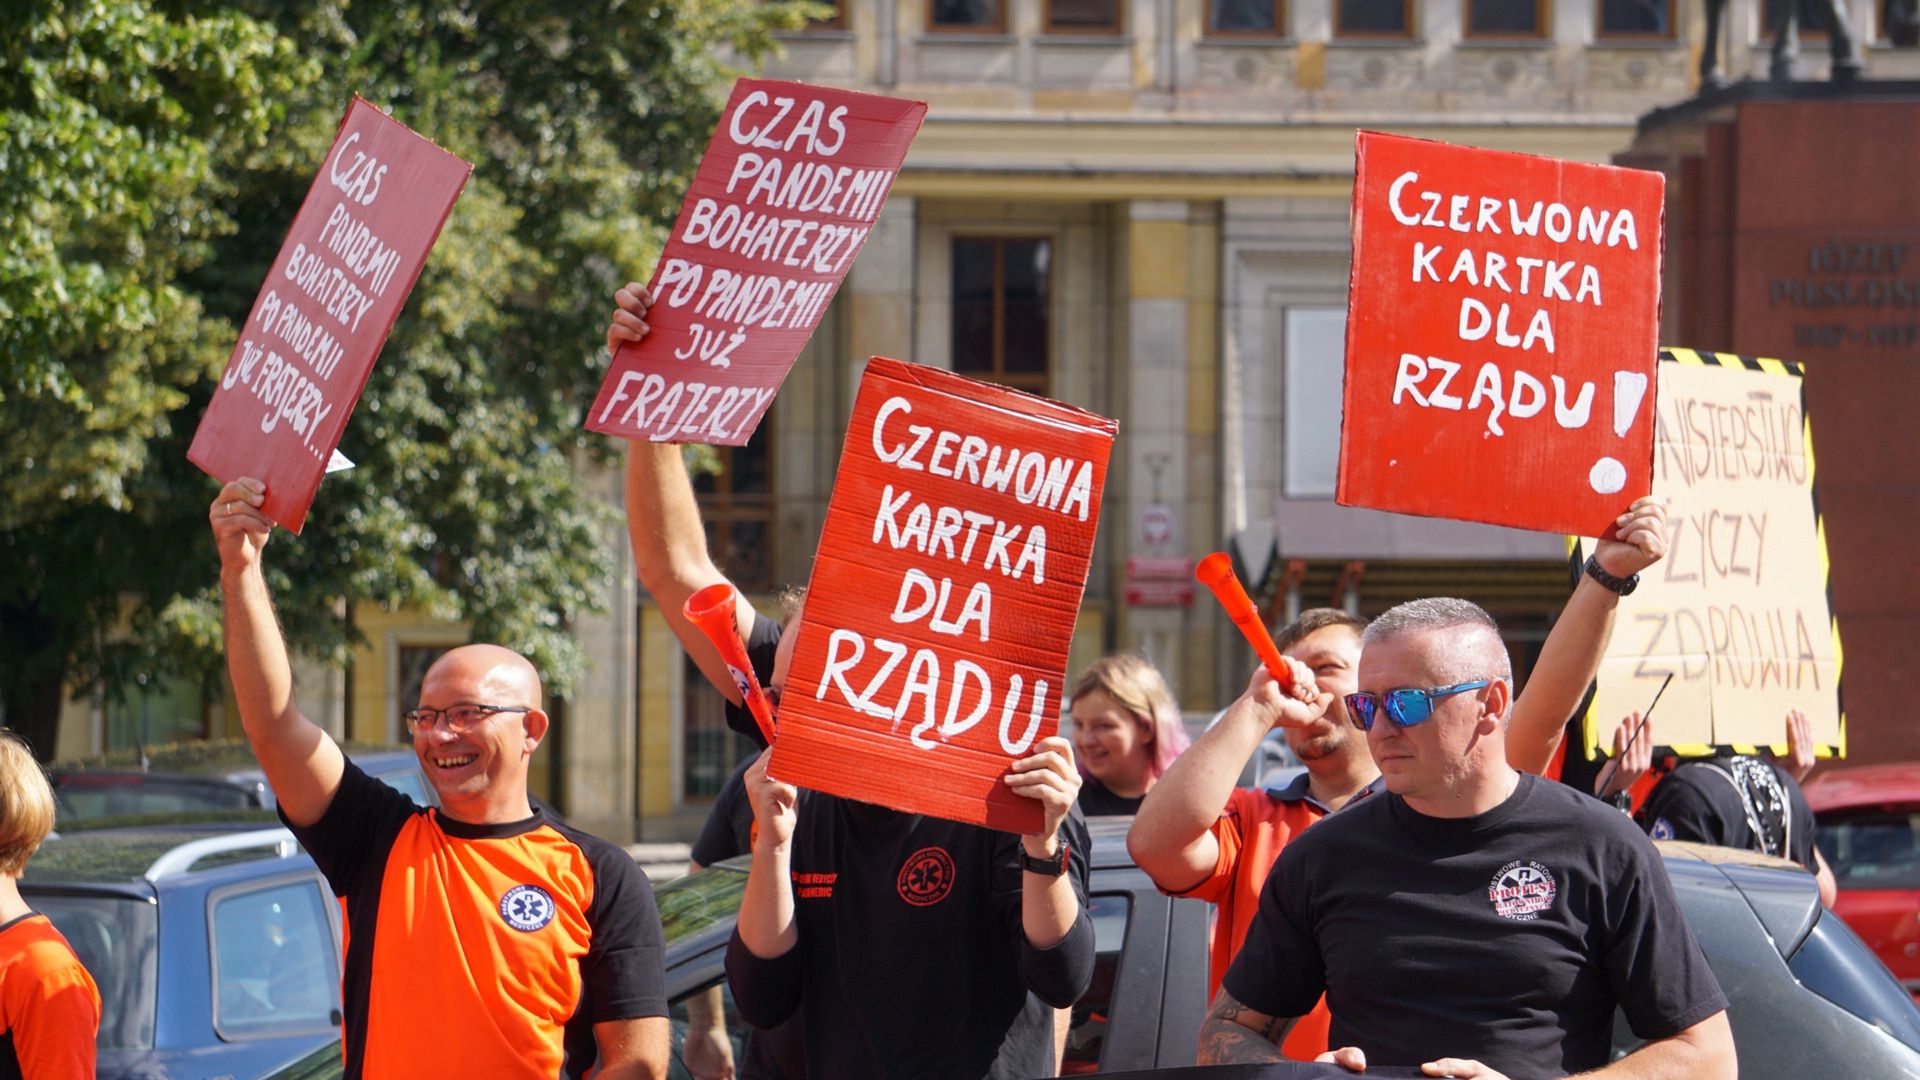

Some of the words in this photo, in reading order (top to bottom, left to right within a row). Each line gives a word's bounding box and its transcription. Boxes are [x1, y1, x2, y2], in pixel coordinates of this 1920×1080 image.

[729, 91, 848, 156] CZAS
[330, 132, 388, 206] CZAS
[726, 152, 893, 222] PANDEMII
[681, 199, 868, 274] BOHATERZY
[1388, 170, 1638, 250] CZERWONA
[318, 203, 400, 297] PANDEMII
[1411, 241, 1601, 305] KARTKA
[284, 243, 374, 333] BOHATERZY
[651, 258, 703, 308] PO
[698, 269, 833, 329] PANDEMII
[1458, 297, 1555, 353] DLA
[222, 340, 263, 391] JUŻ
[256, 290, 277, 333] PO
[274, 303, 344, 381] PANDEMII
[674, 323, 746, 369] JUŻ
[599, 371, 775, 442] FRAJERZY
[1656, 391, 1806, 488] NISTERSTWO
[872, 396, 1093, 522] CZERWONA
[872, 484, 1046, 584] KARTKA
[890, 568, 991, 643] DLA
[1634, 604, 1820, 691] ZDROWIA
[816, 628, 1048, 756] RZĄDU
